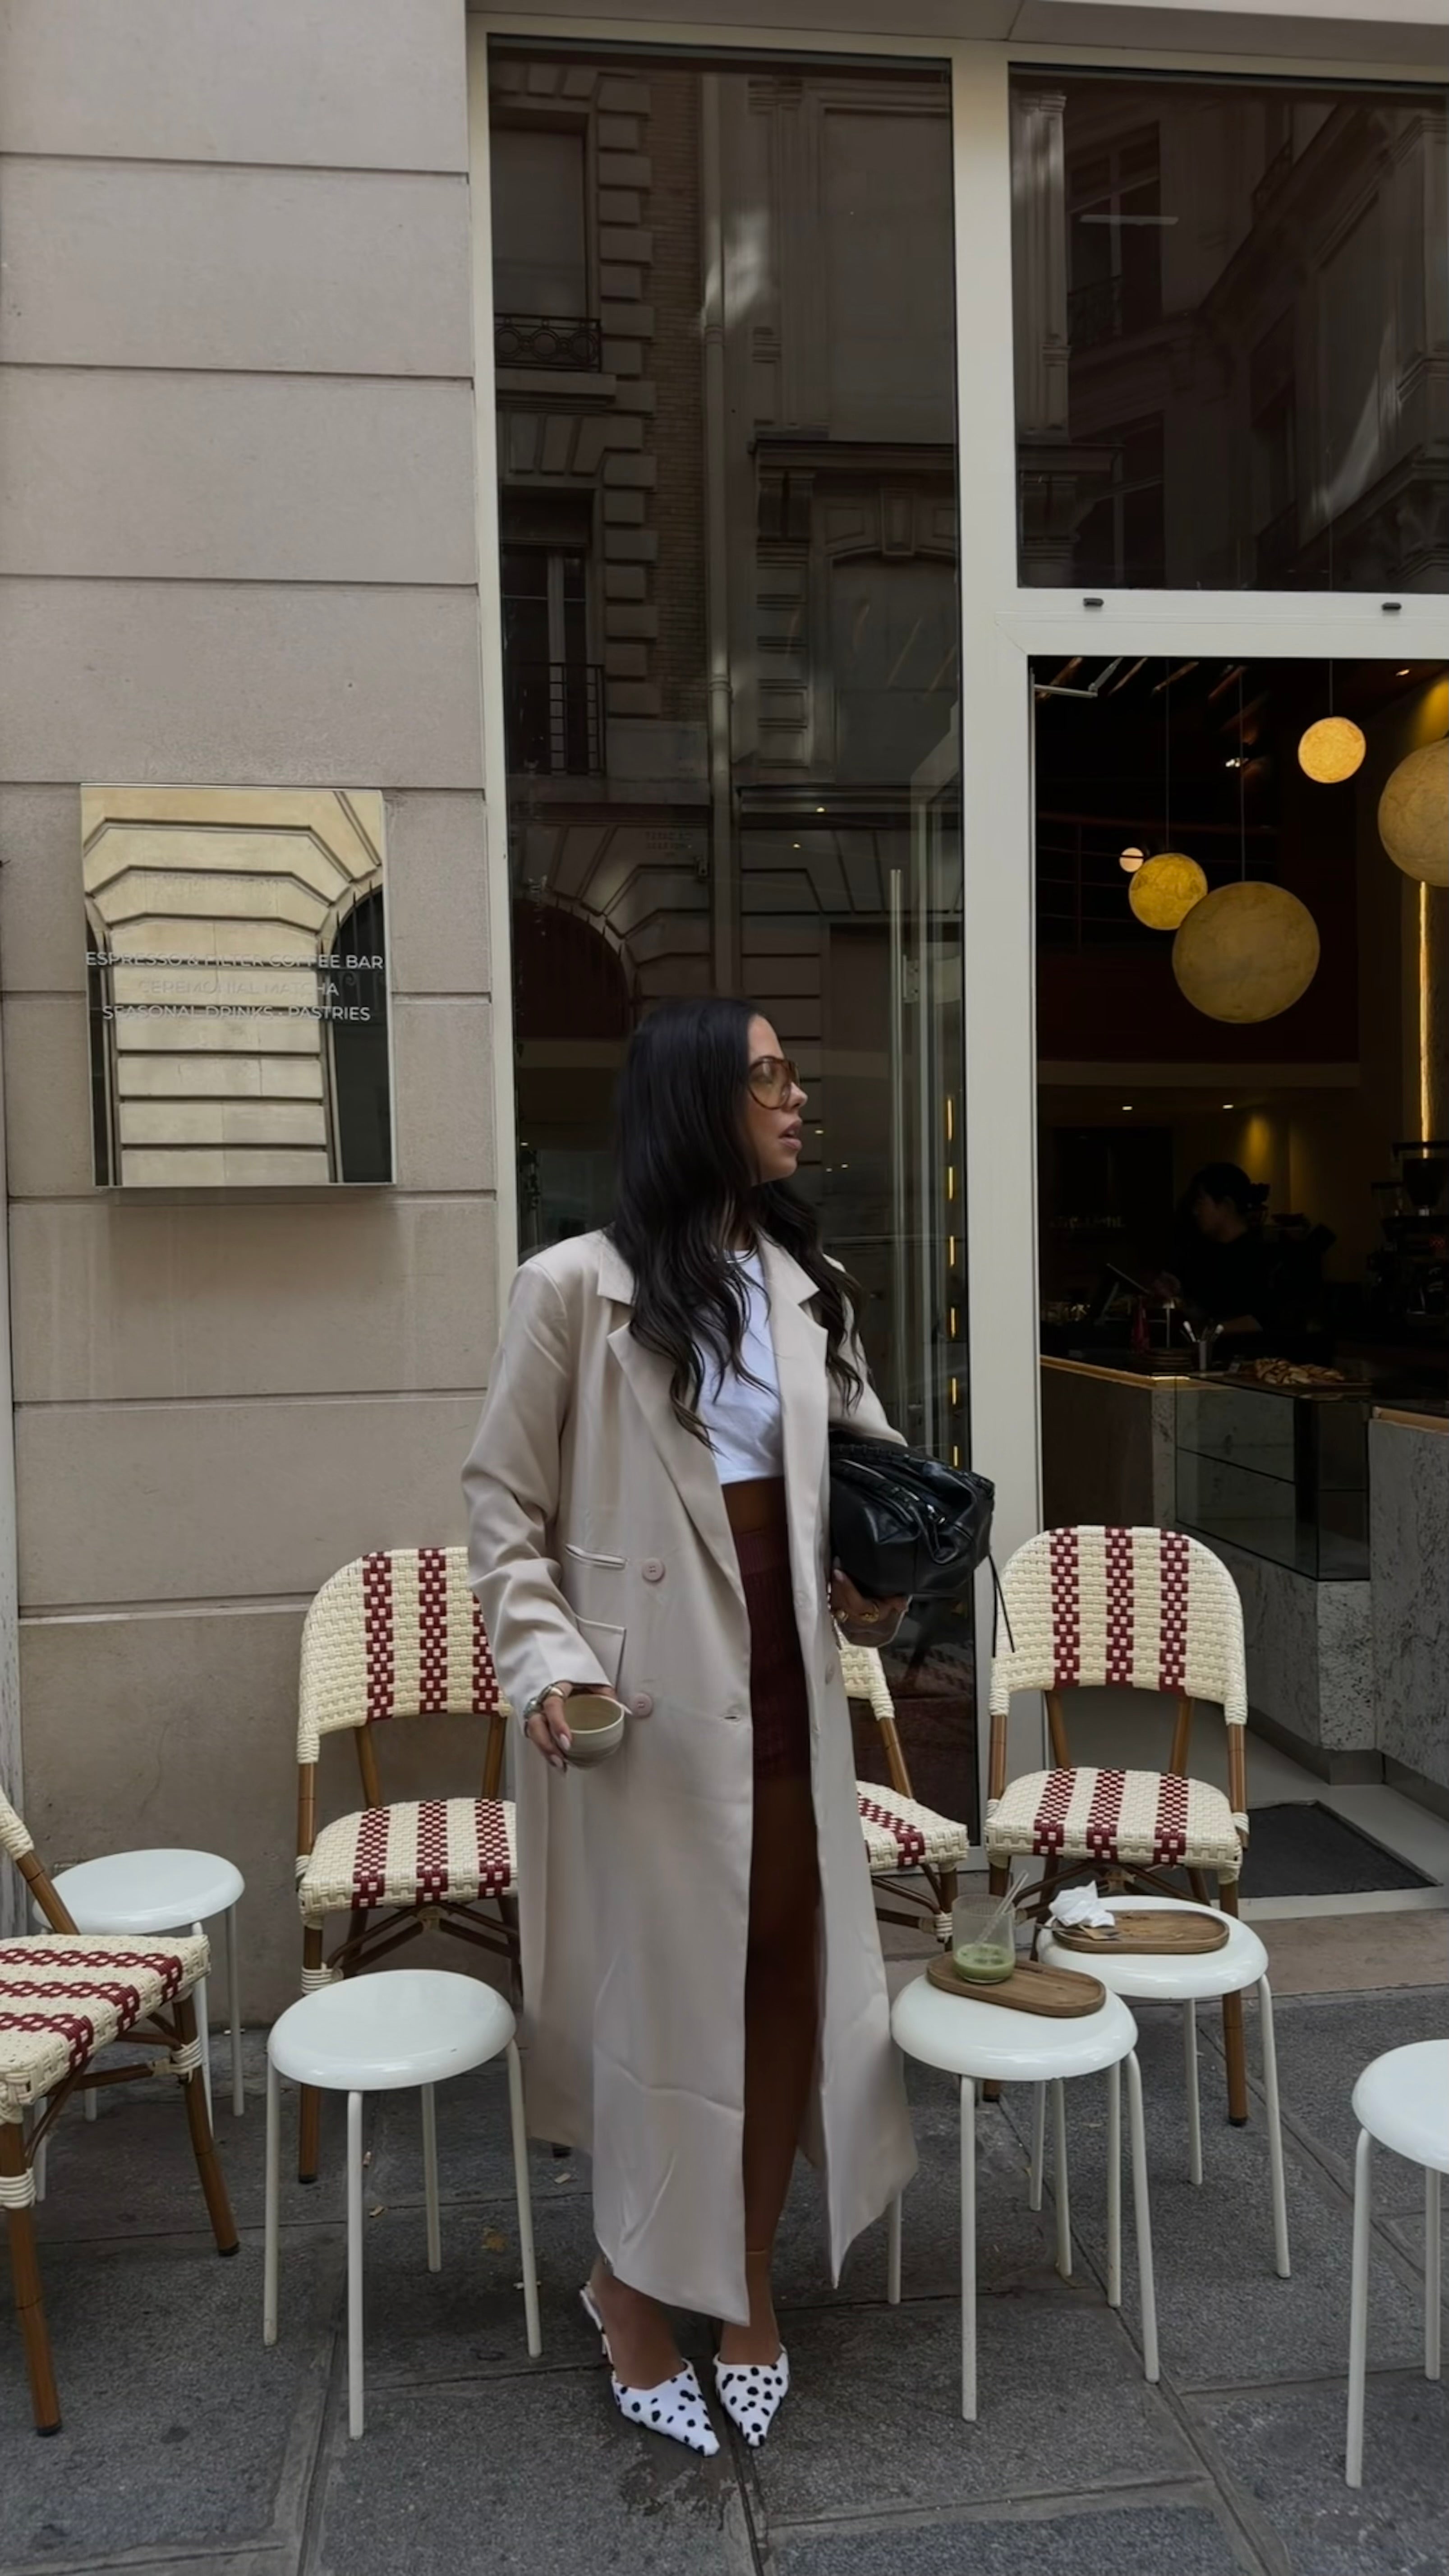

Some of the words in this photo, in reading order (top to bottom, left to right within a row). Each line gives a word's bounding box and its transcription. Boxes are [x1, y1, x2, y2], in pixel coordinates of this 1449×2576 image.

[86, 952, 181, 966] ESPRESSO
[188, 953, 198, 966] &
[205, 953, 264, 967] FILTER
[270, 954, 340, 968] COFFEE
[345, 954, 383, 969] BAR
[102, 1005, 203, 1019] SEASONAL
[206, 1006, 273, 1020] DRINKS
[289, 1006, 371, 1021] PASTRIES
